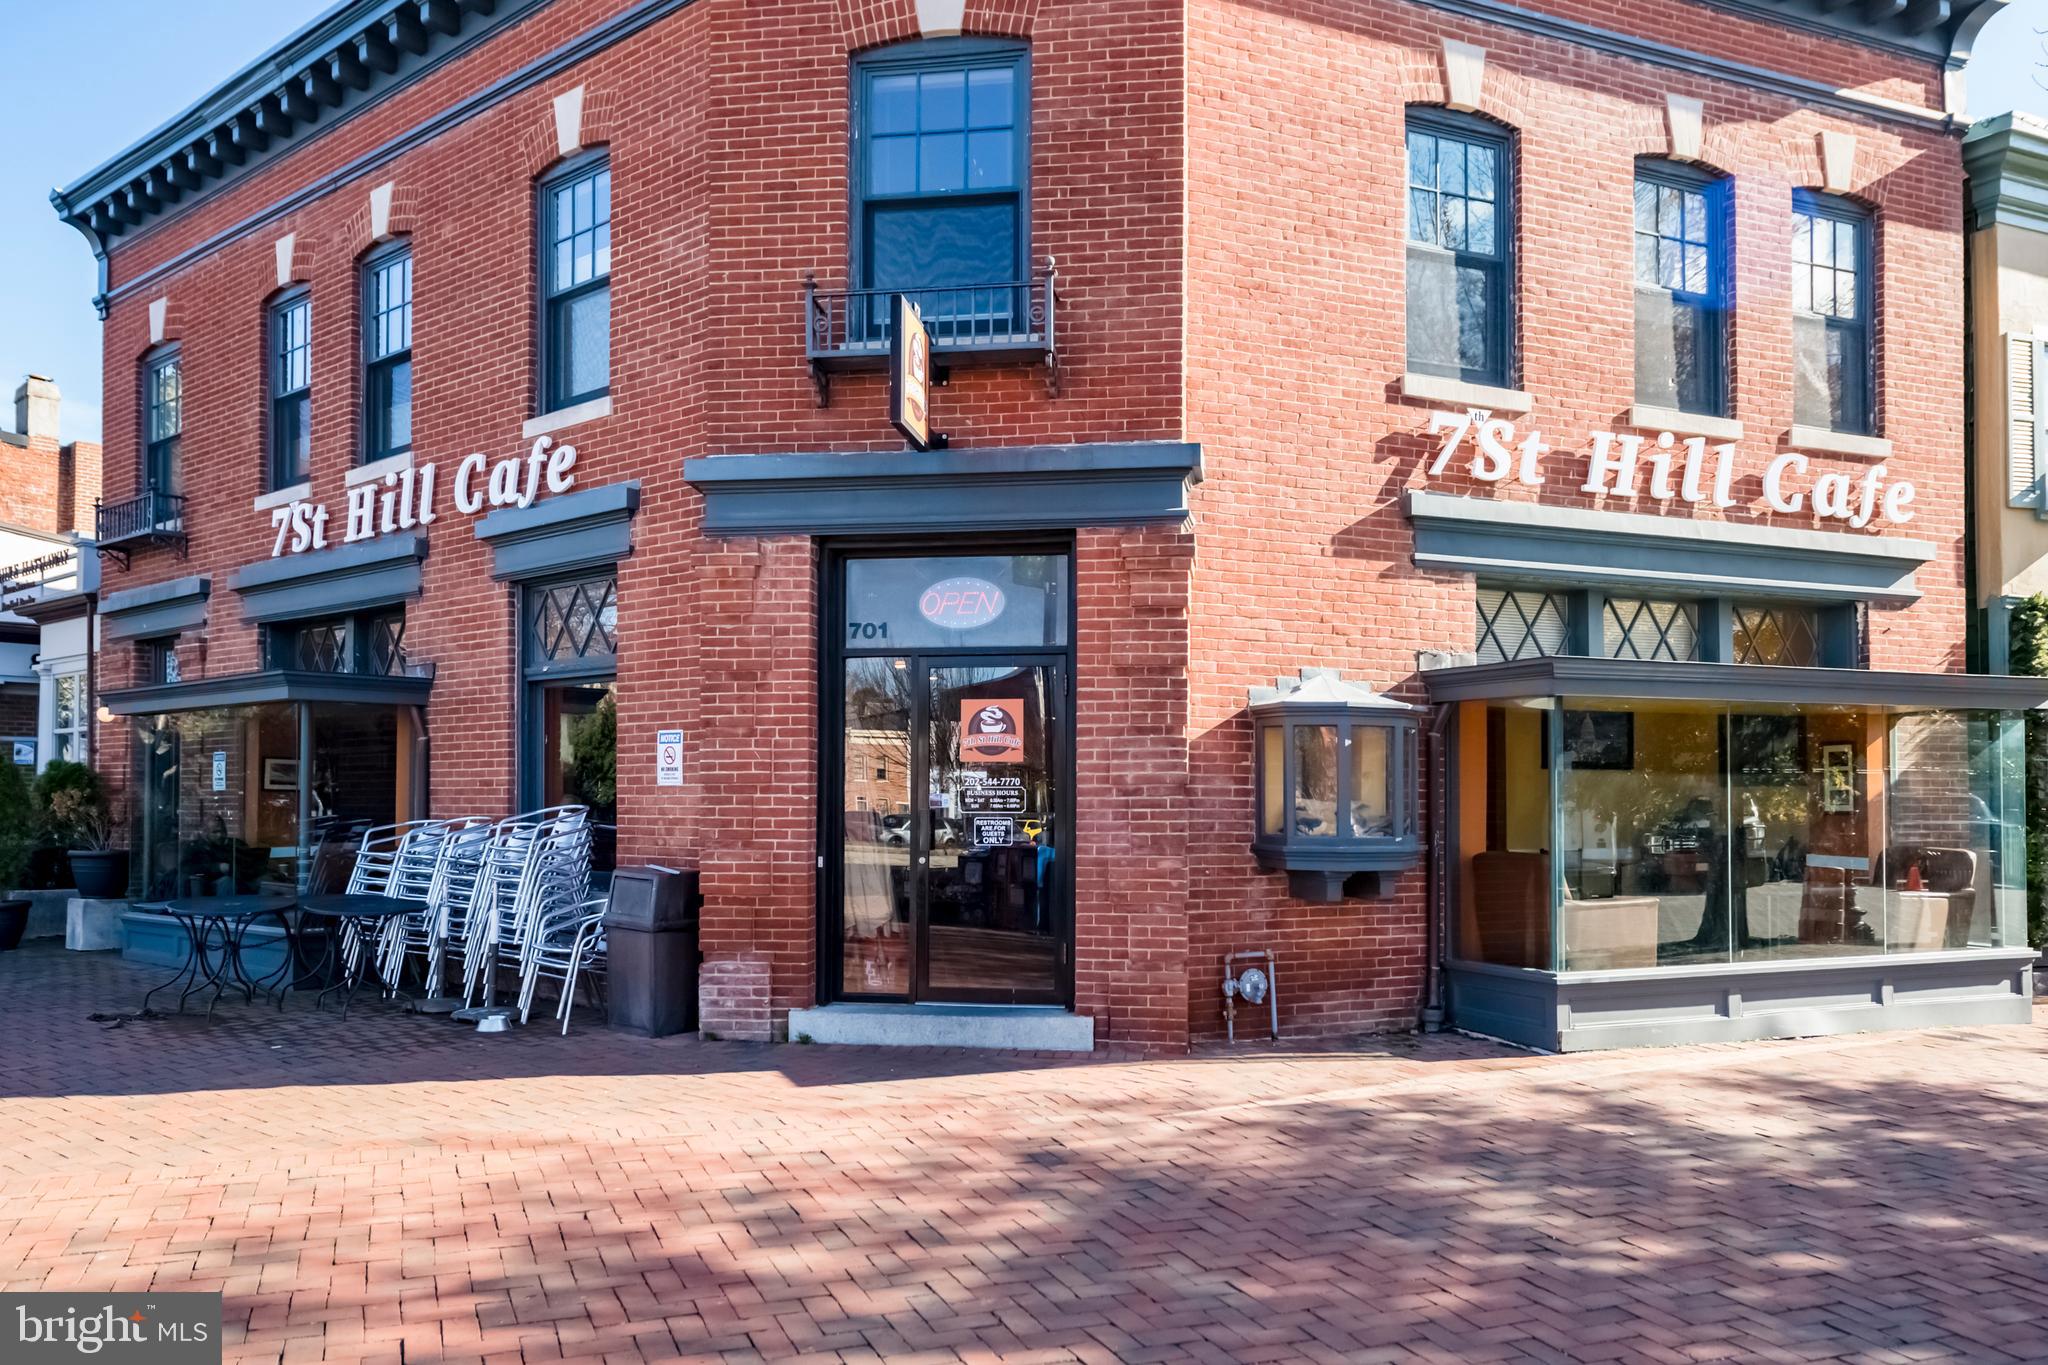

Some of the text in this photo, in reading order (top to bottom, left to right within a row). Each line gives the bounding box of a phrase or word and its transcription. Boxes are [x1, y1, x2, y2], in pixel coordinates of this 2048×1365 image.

[344, 462, 436, 542] Hill
[454, 435, 577, 514] Cafe
[1581, 431, 1737, 508] Hill
[1763, 453, 1915, 528] Cafe
[920, 591, 999, 616] OPEN
[849, 622, 888, 639] 701
[965, 777, 1020, 786] 202-544-7770
